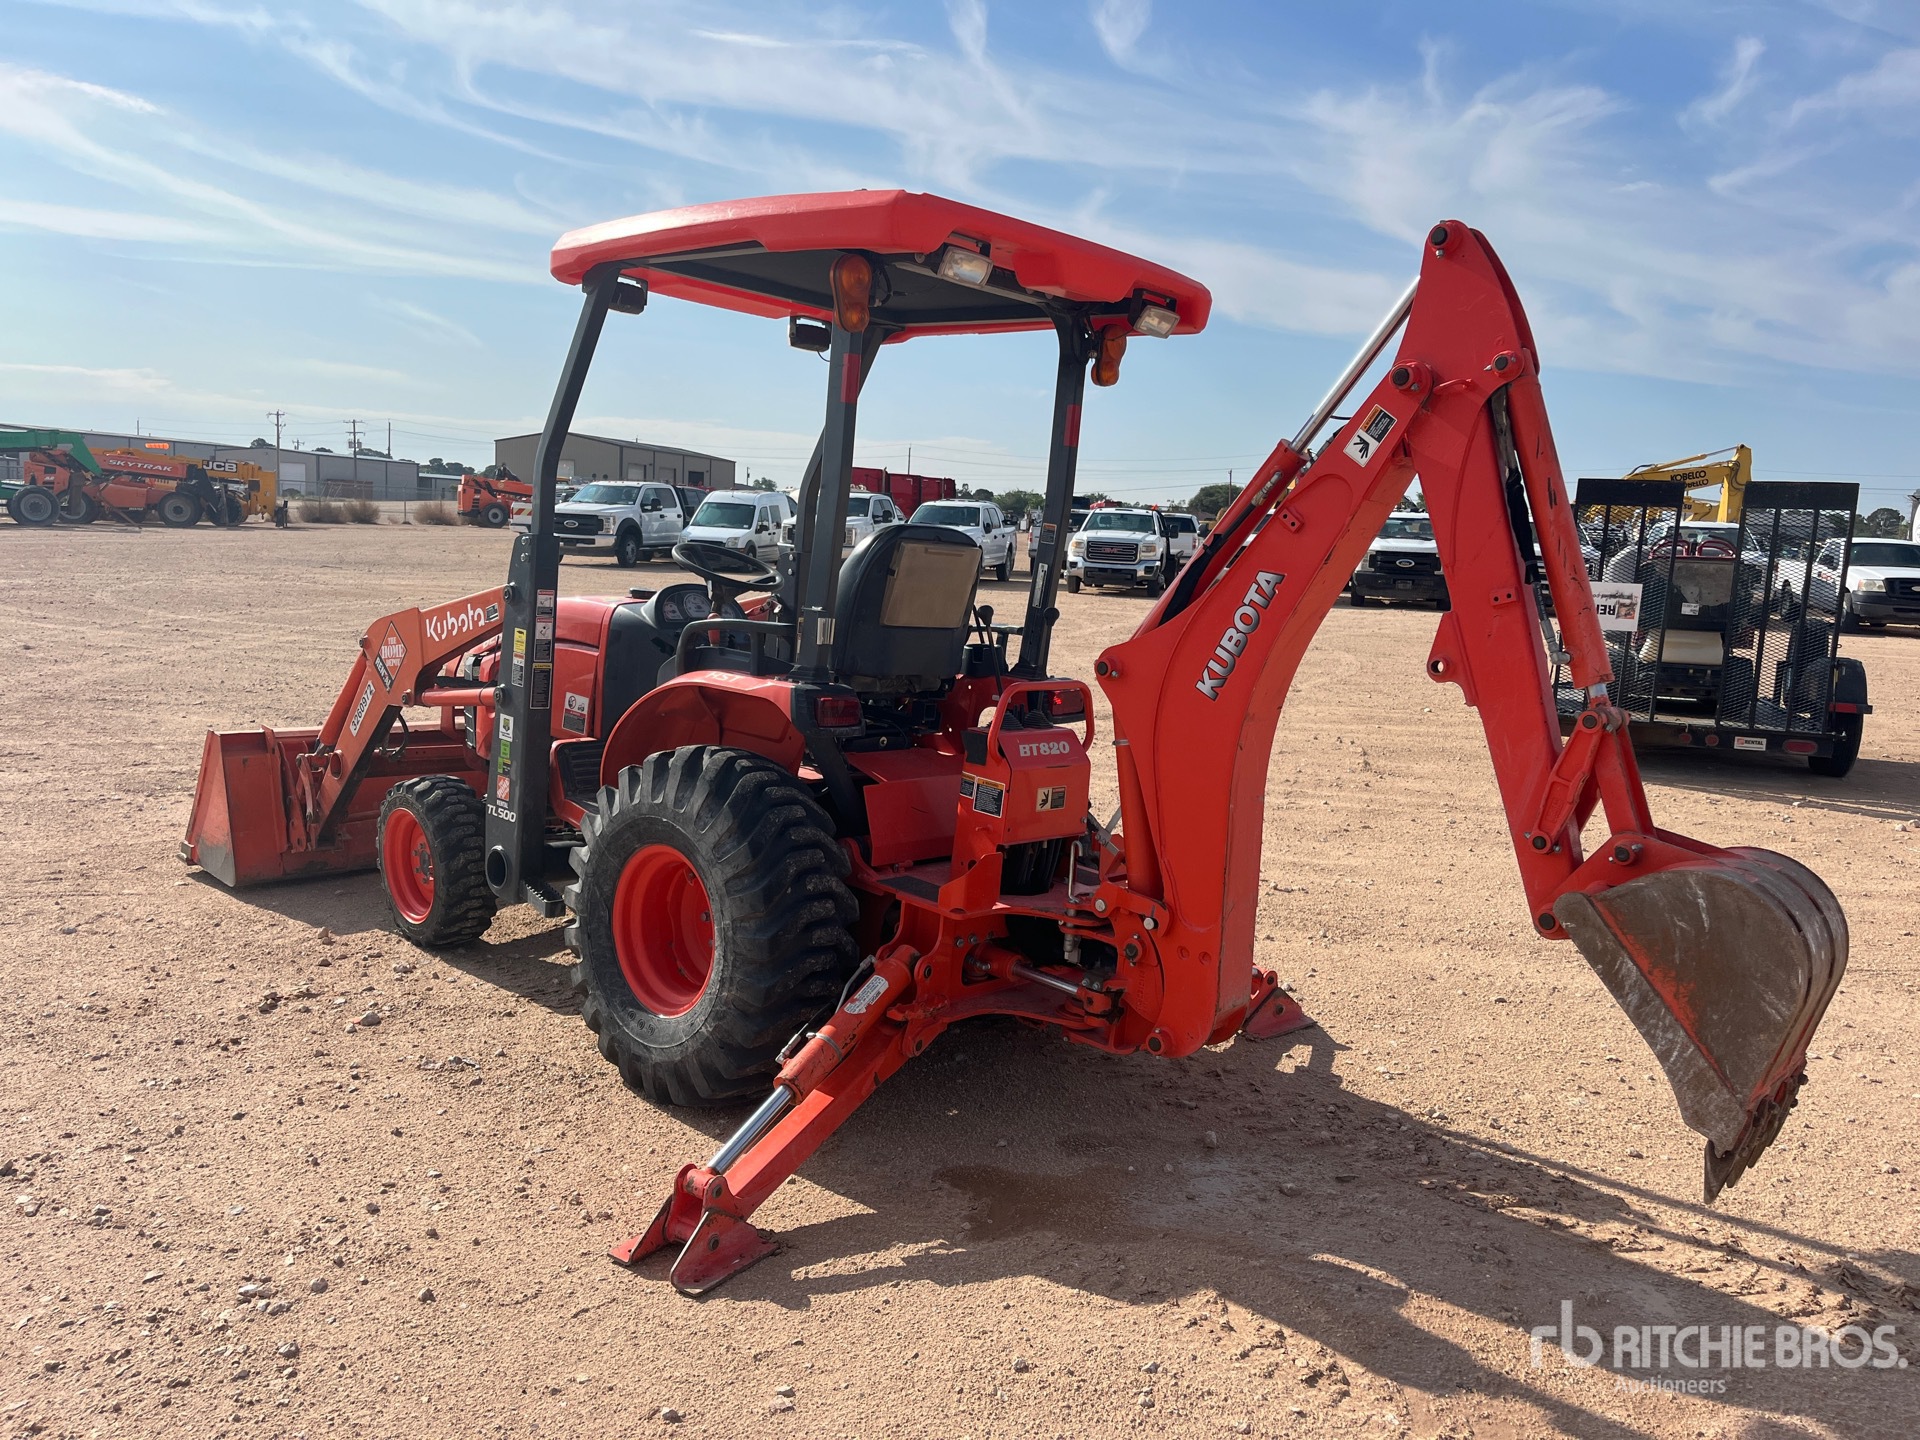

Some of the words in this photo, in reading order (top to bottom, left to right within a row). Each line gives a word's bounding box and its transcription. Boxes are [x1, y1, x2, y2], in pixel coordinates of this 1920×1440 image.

[109, 458, 173, 472] SKYTRAK
[203, 460, 237, 473] JCB
[1670, 470, 1707, 481] KOBELCO
[425, 603, 485, 642] Kubota
[1196, 570, 1287, 702] KUBOTA
[381, 644, 403, 659] HOME
[352, 684, 374, 731] 3260972
[1019, 739, 1070, 758] BT820
[487, 804, 517, 823] TL500
